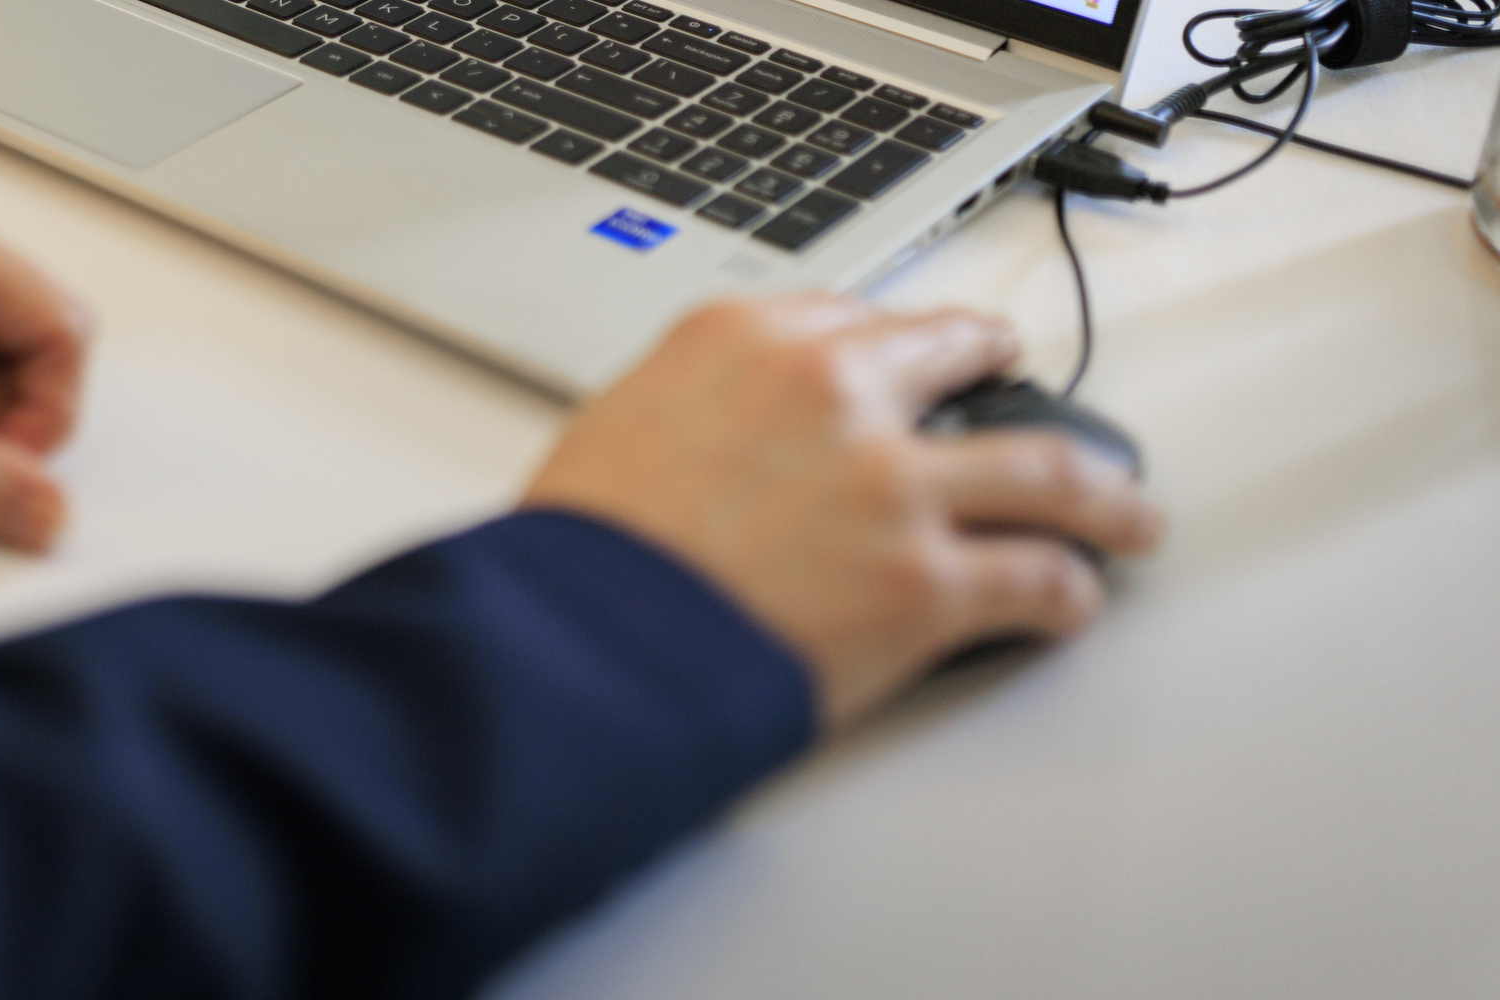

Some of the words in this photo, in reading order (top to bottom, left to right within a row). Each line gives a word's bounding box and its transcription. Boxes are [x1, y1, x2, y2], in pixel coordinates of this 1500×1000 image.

[378, 3, 400, 14] K
[315, 13, 339, 25] M
[501, 13, 521, 22] P
[427, 20, 440, 31] L
[729, 33, 758, 46] delete
[328, 53, 342, 61] alt
[684, 44, 731, 64] backspace
[782, 52, 810, 65] home
[377, 71, 395, 80] ctrl
